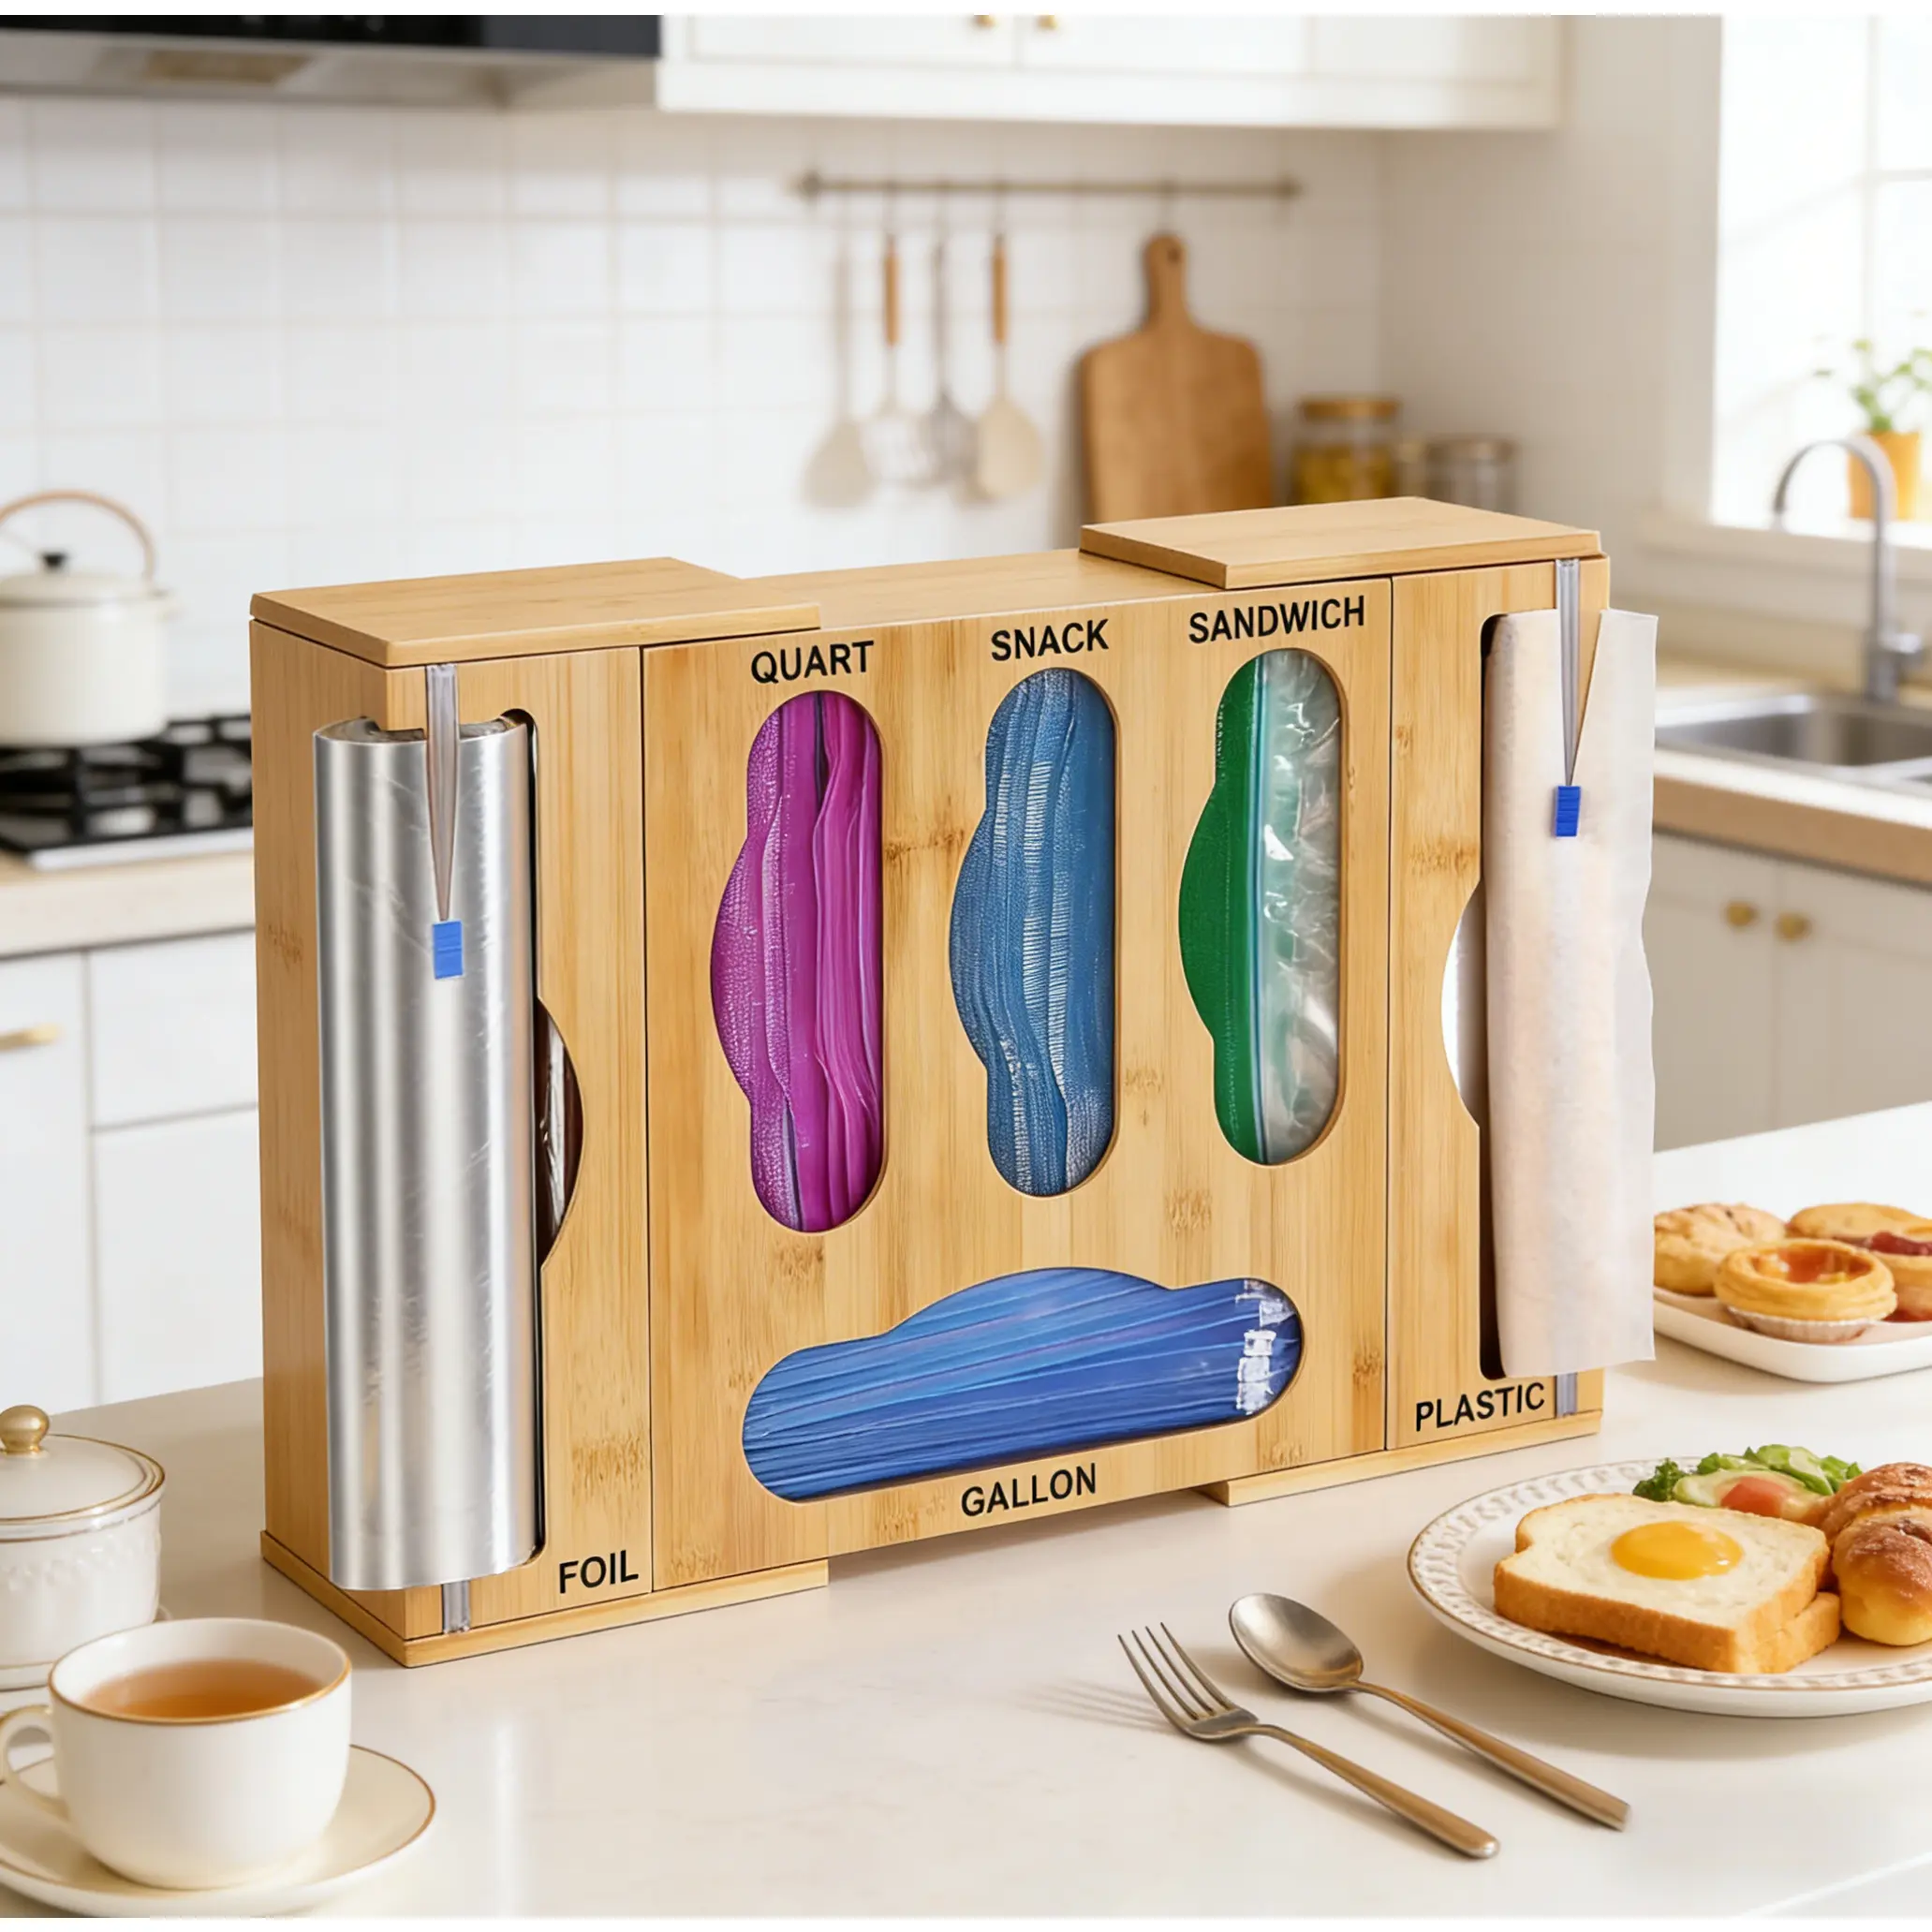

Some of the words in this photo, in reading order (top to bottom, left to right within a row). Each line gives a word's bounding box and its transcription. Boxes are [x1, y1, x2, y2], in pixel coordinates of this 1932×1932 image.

[991, 618, 1110, 661] SNACK
[1188, 595, 1365, 644] SANDWICH
[750, 640, 876, 686] QUART
[1415, 1381, 1546, 1432] PLASTIC
[961, 1462, 1097, 1517] GALLON
[559, 1549, 640, 1594] FOIL
